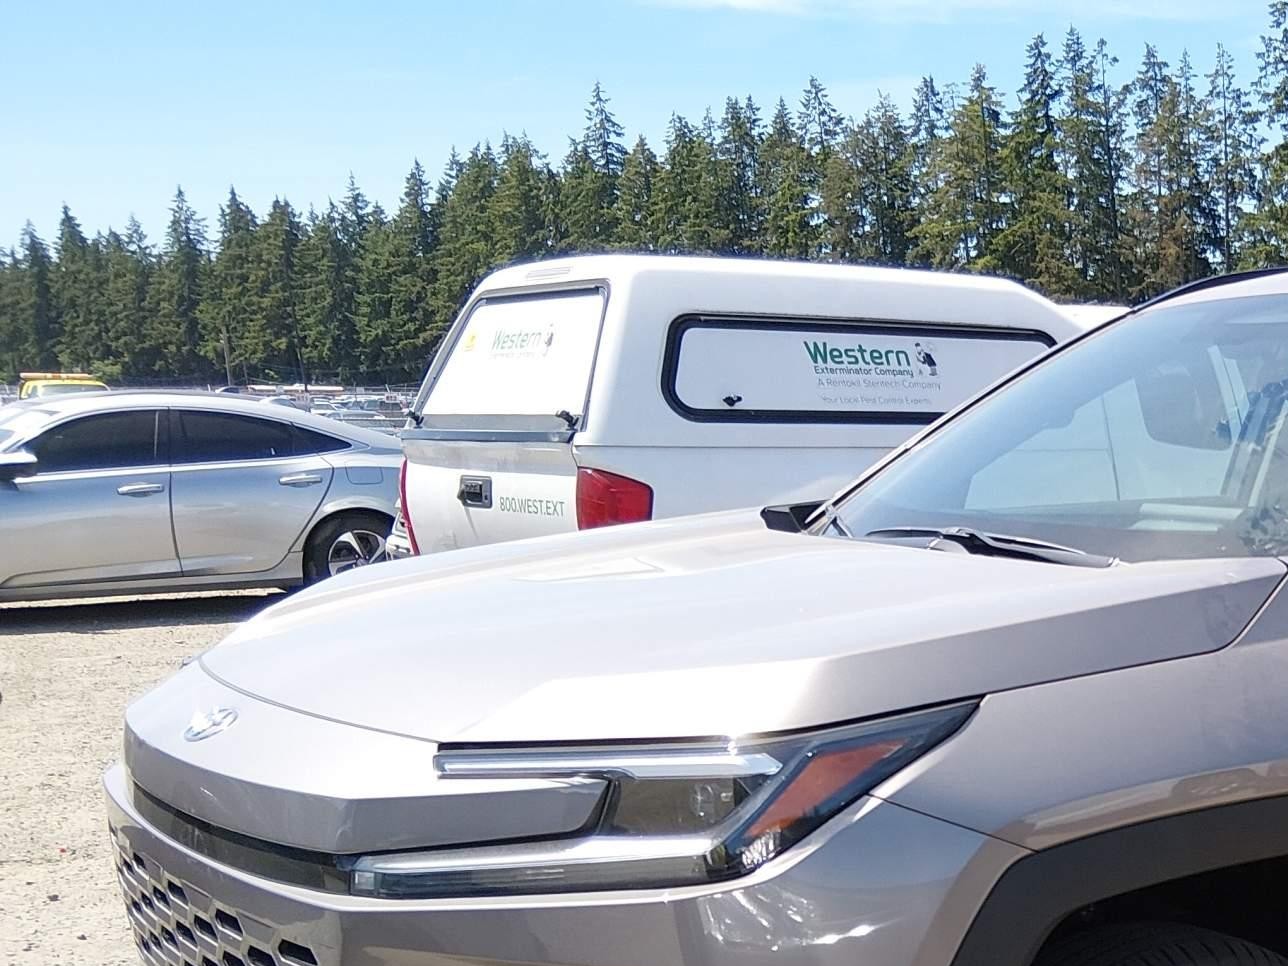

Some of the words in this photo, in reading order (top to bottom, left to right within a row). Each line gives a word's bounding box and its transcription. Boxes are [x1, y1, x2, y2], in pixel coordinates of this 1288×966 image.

[491, 330, 542, 350] Western
[803, 340, 911, 367] Western
[813, 365, 873, 376] Exterminator
[874, 367, 914, 378] Company
[901, 380, 941, 391] Company
[499, 496, 565, 516] 800.WEST.EXT
